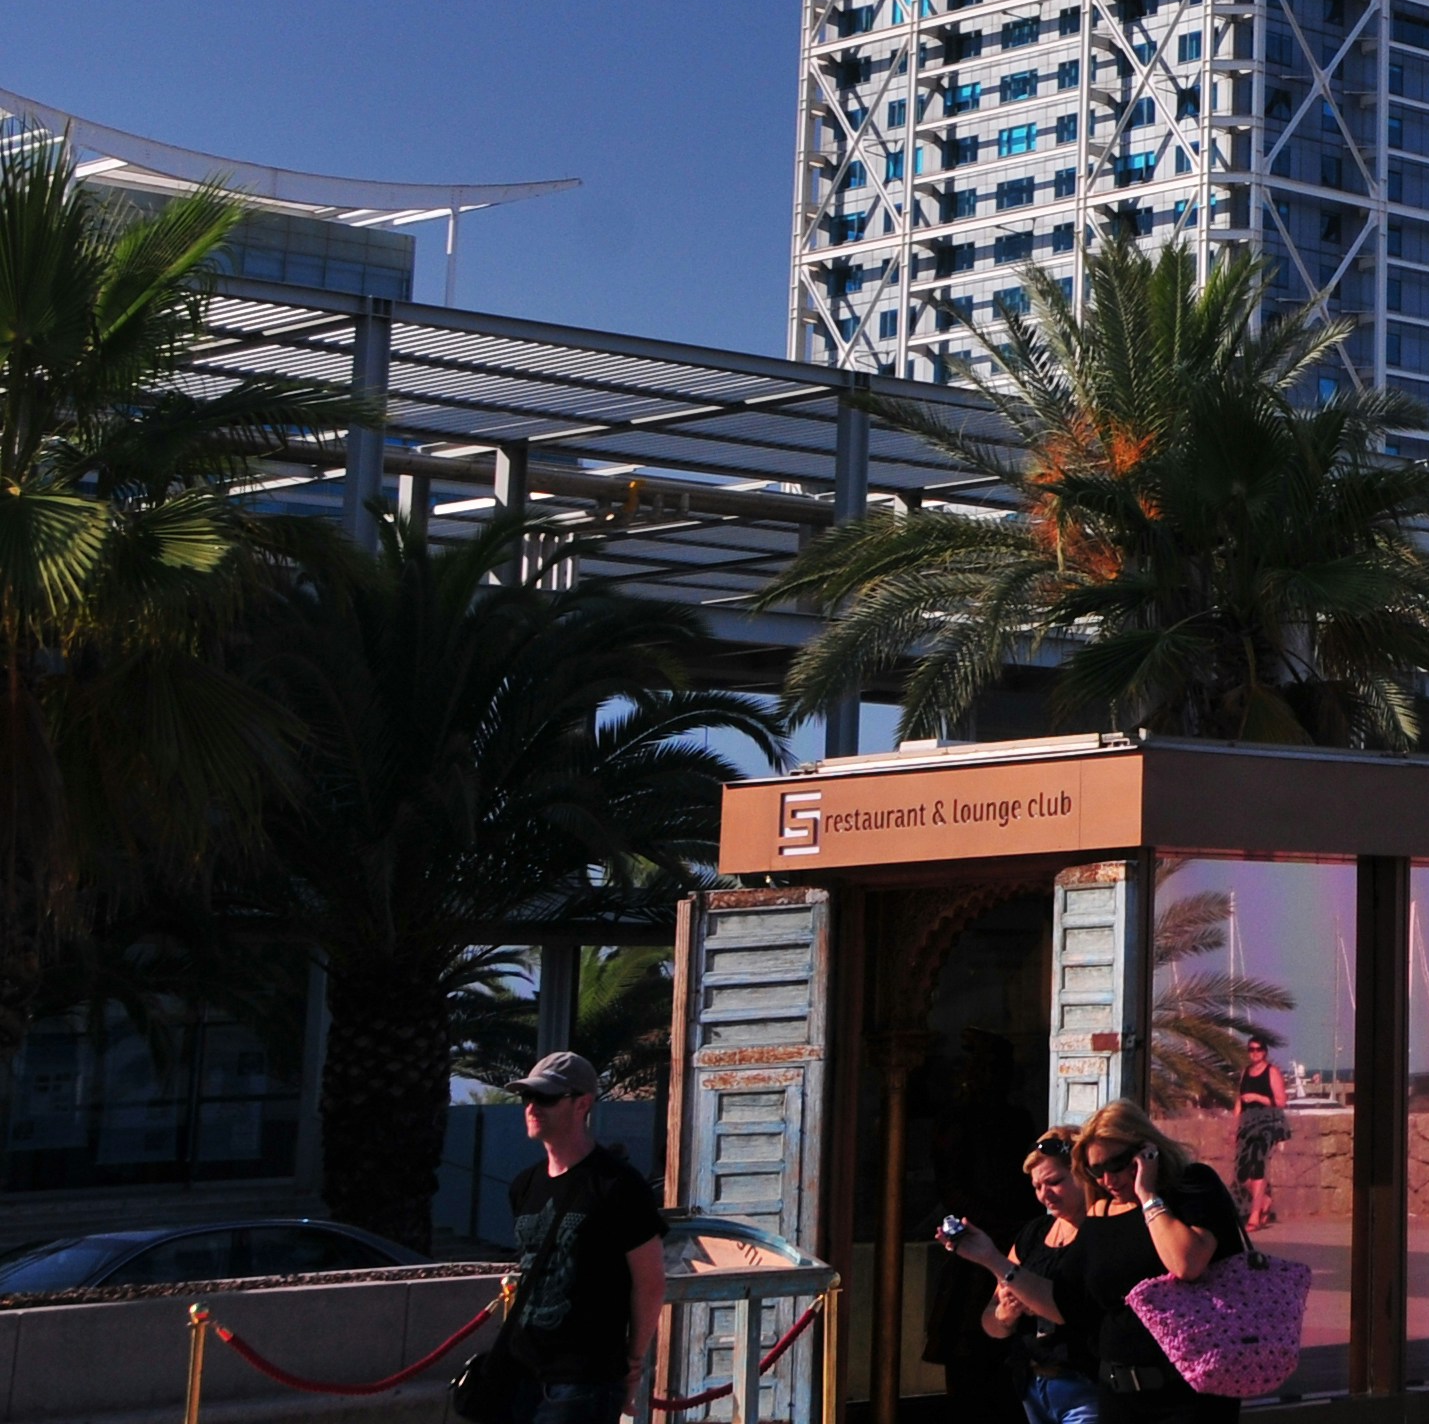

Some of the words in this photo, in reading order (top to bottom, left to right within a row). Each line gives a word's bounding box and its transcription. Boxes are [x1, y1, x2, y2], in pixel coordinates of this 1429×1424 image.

[824, 803, 926, 833] restaurant
[932, 800, 947, 825] &
[953, 798, 1022, 827] lounge
[1028, 790, 1072, 819] club
